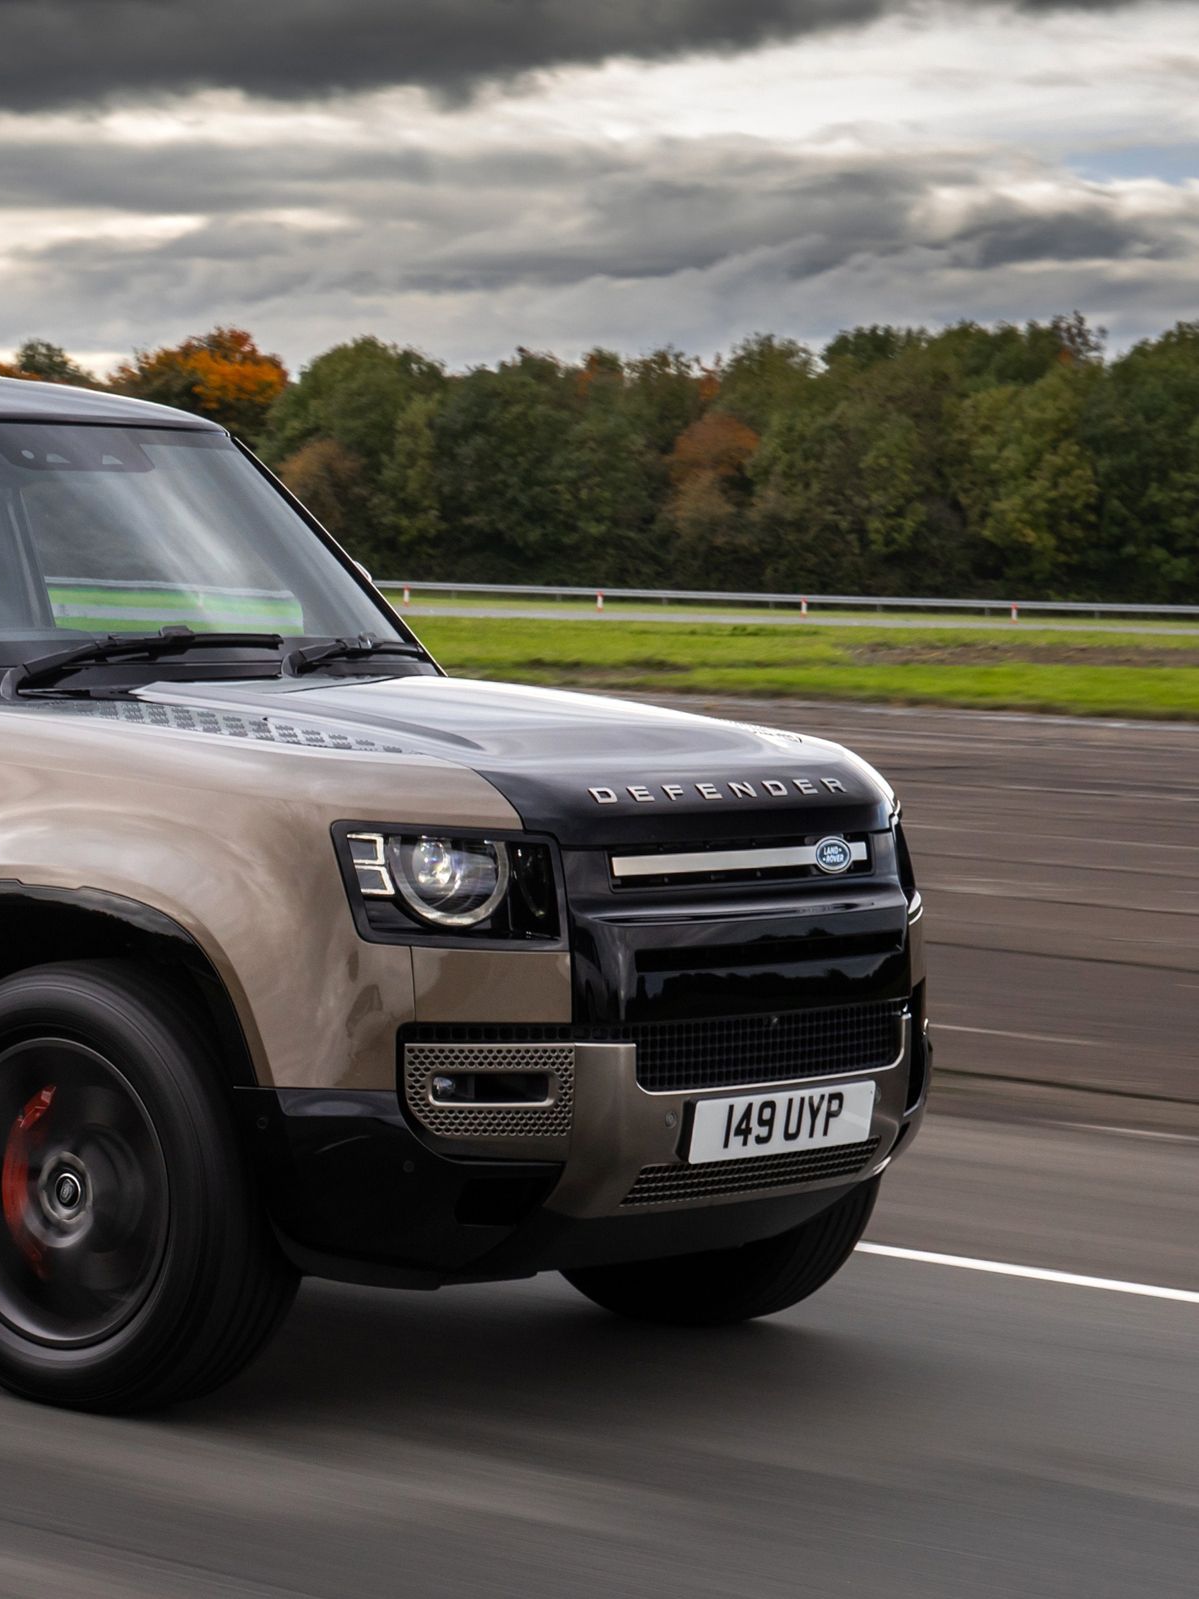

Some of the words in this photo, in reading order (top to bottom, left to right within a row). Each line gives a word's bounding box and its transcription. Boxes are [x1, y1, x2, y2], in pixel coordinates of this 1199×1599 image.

[588, 777, 847, 804] DEFENDER
[823, 845, 839, 855] LAND
[826, 853, 844, 863] ROVER
[723, 1100, 777, 1149] 149
[783, 1092, 844, 1142] UYP
